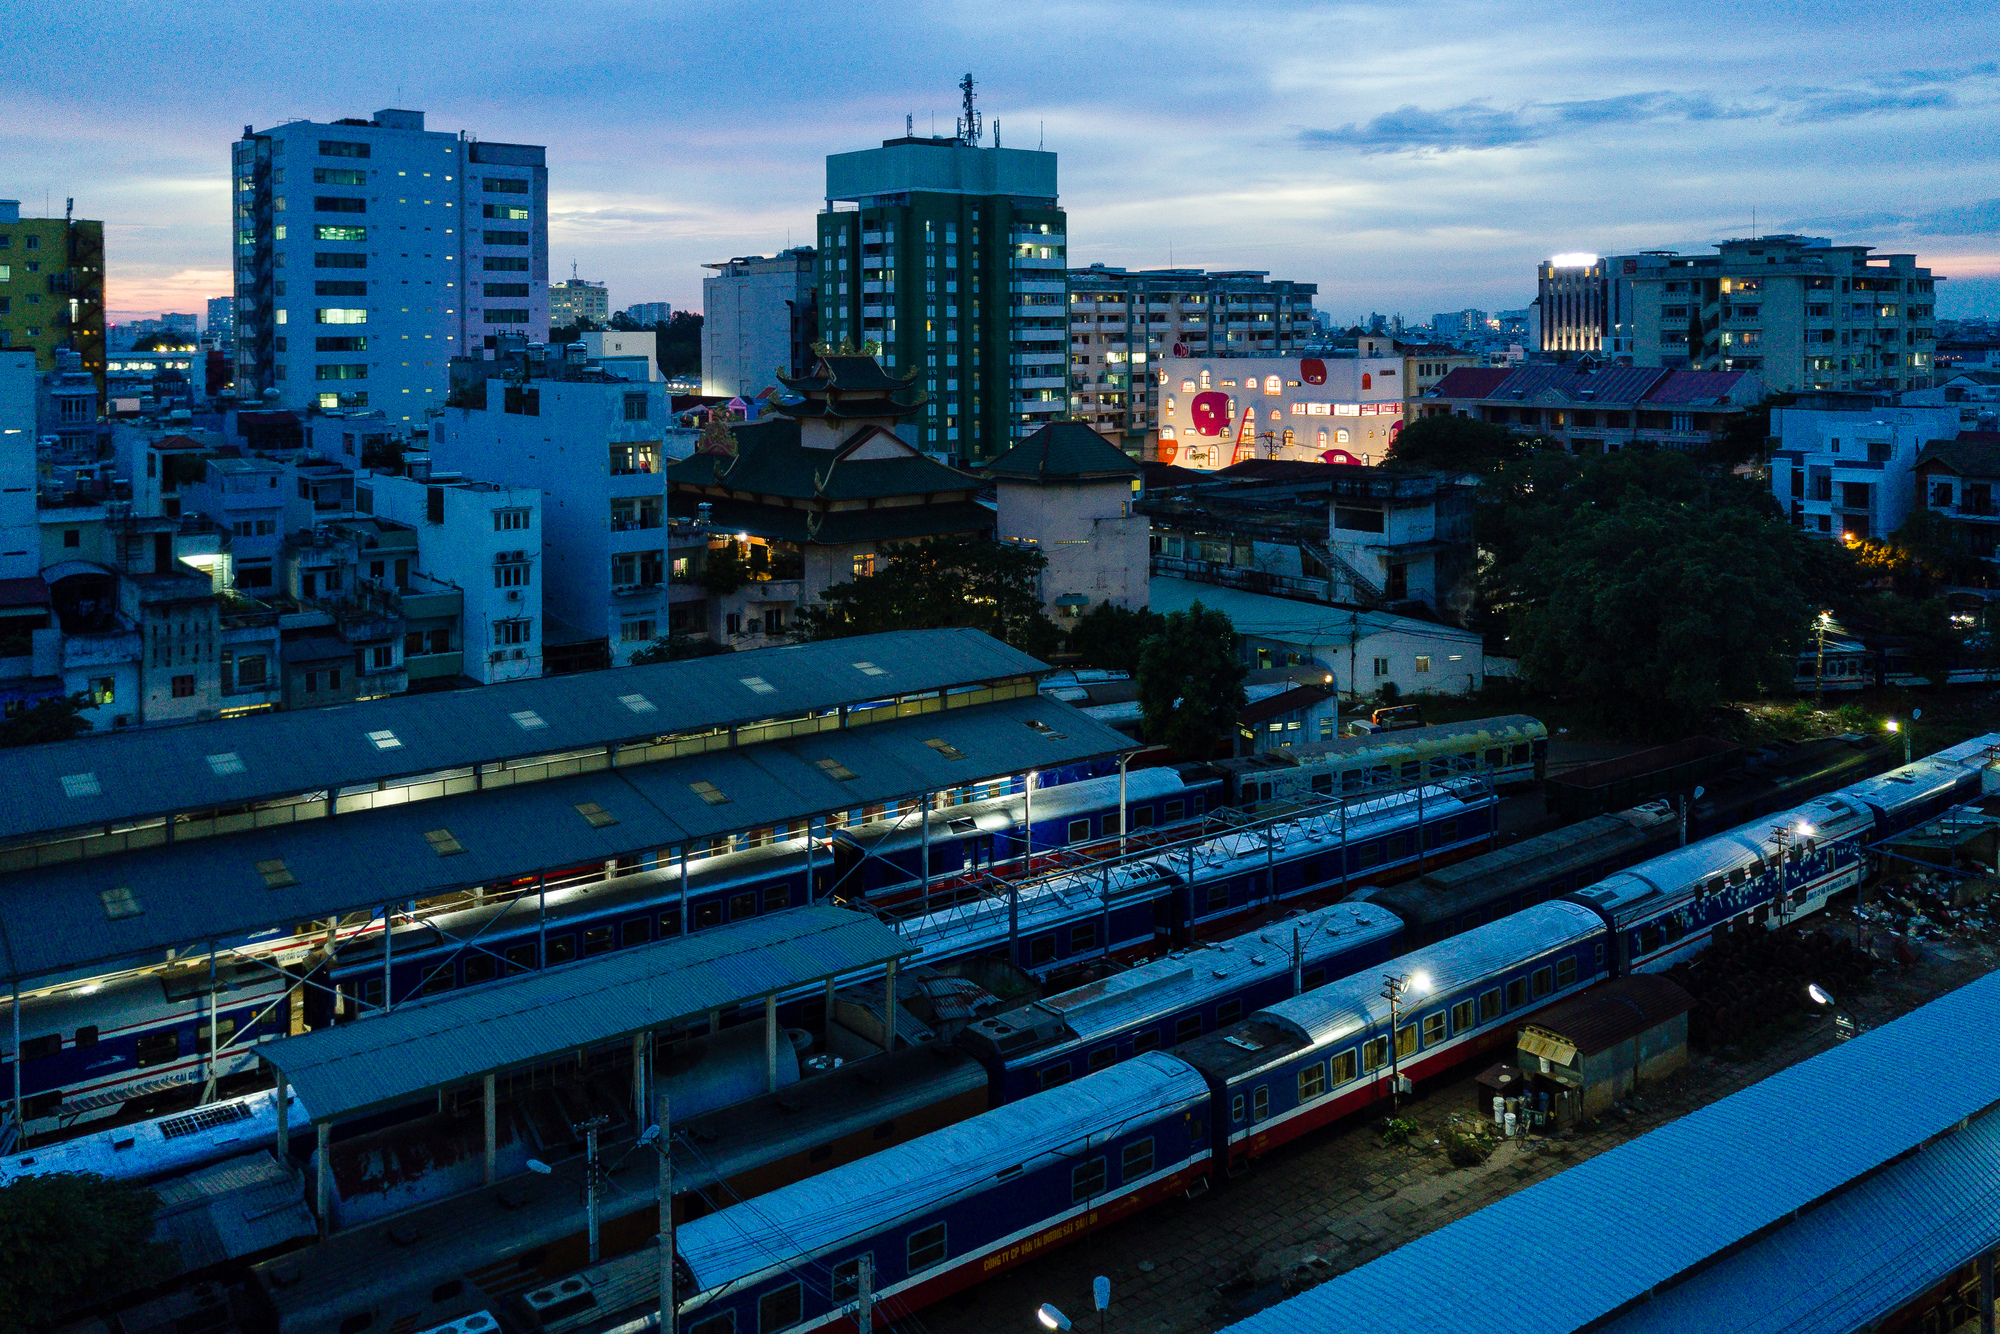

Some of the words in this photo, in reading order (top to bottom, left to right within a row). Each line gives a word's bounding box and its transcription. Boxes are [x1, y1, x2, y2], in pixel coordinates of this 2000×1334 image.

[983, 1254, 1002, 1271] CÔNG
[1002, 1250, 1010, 1263] TY
[1010, 1246, 1020, 1260] CP
